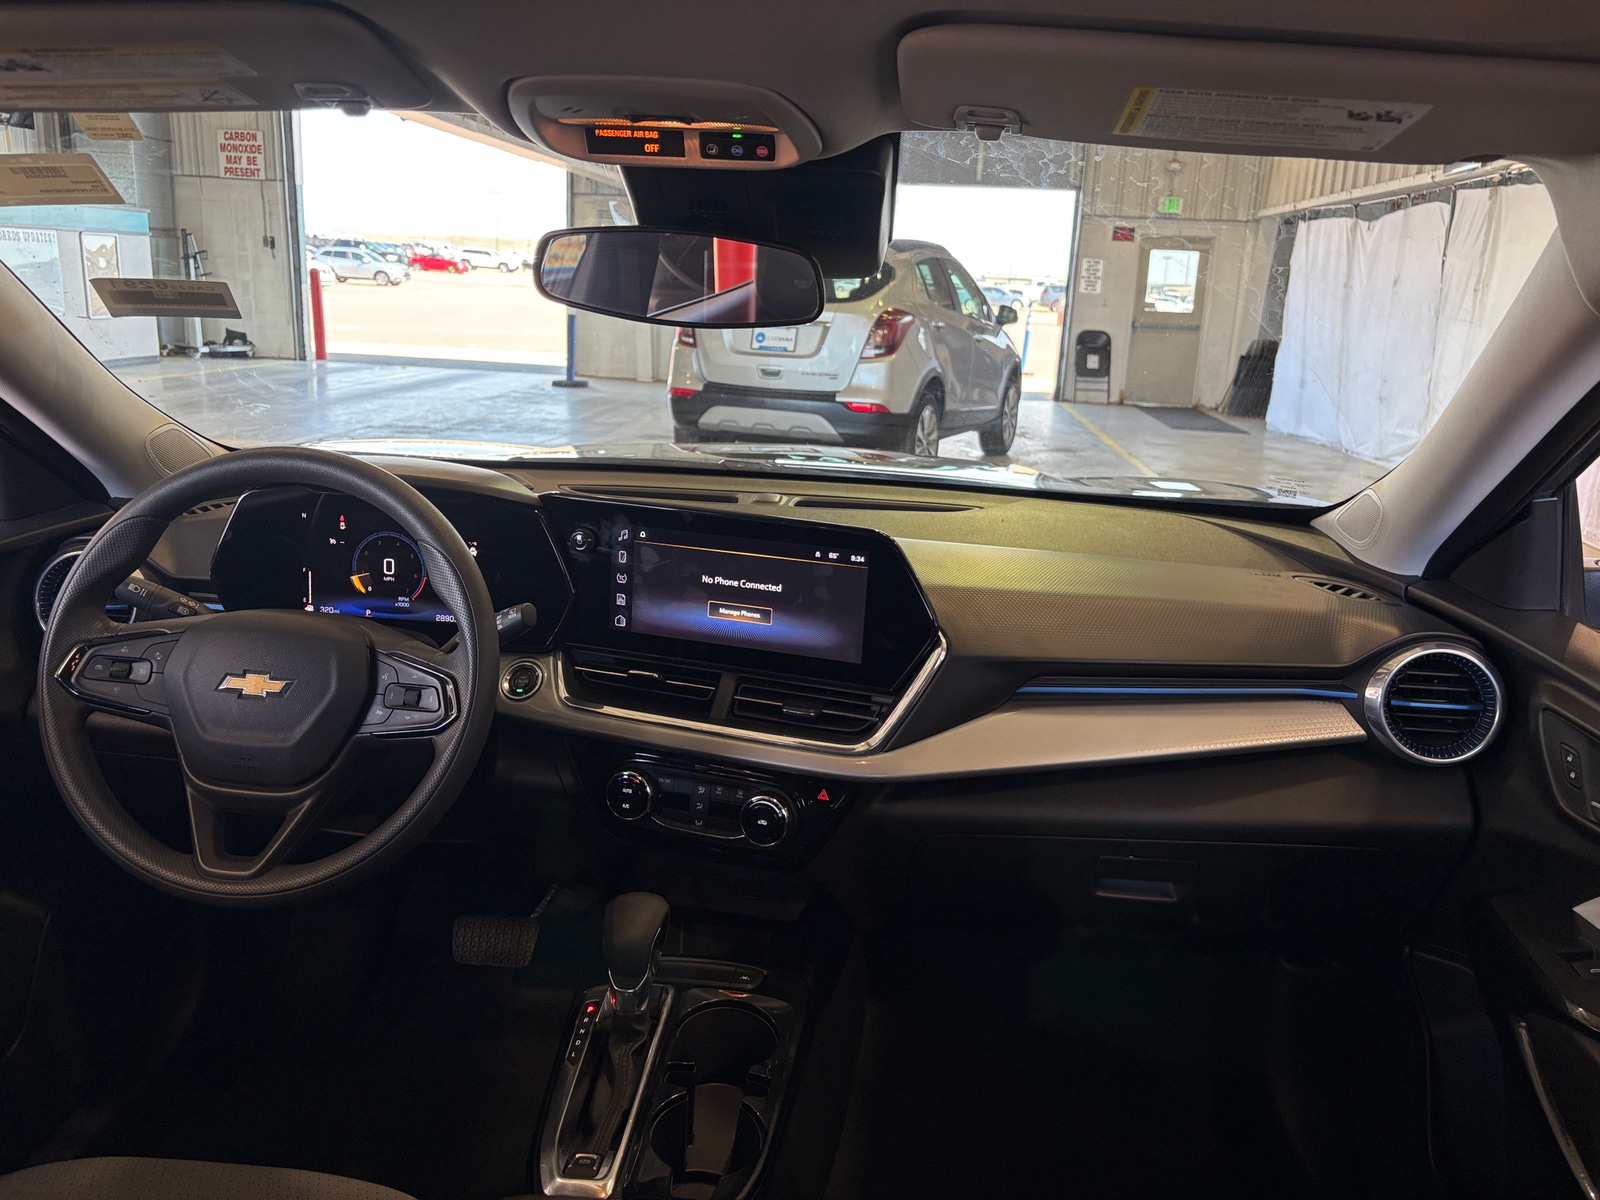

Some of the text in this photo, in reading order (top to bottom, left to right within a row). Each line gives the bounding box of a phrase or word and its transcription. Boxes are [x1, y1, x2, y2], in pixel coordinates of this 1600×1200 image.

[224, 131, 258, 142] CARBON
[595, 129, 632, 138] PASSENGER
[220, 143, 263, 154] MONOXIDE
[644, 143, 660, 153] OFF
[225, 155, 258, 166] MAY BE
[224, 167, 261, 178] PRESENT
[22, 231, 56, 243] UPDATES!
[383, 558, 395, 575] 0
[701, 574, 783, 592] No Phone Connected
[719, 607, 761, 619] Manage Phones
